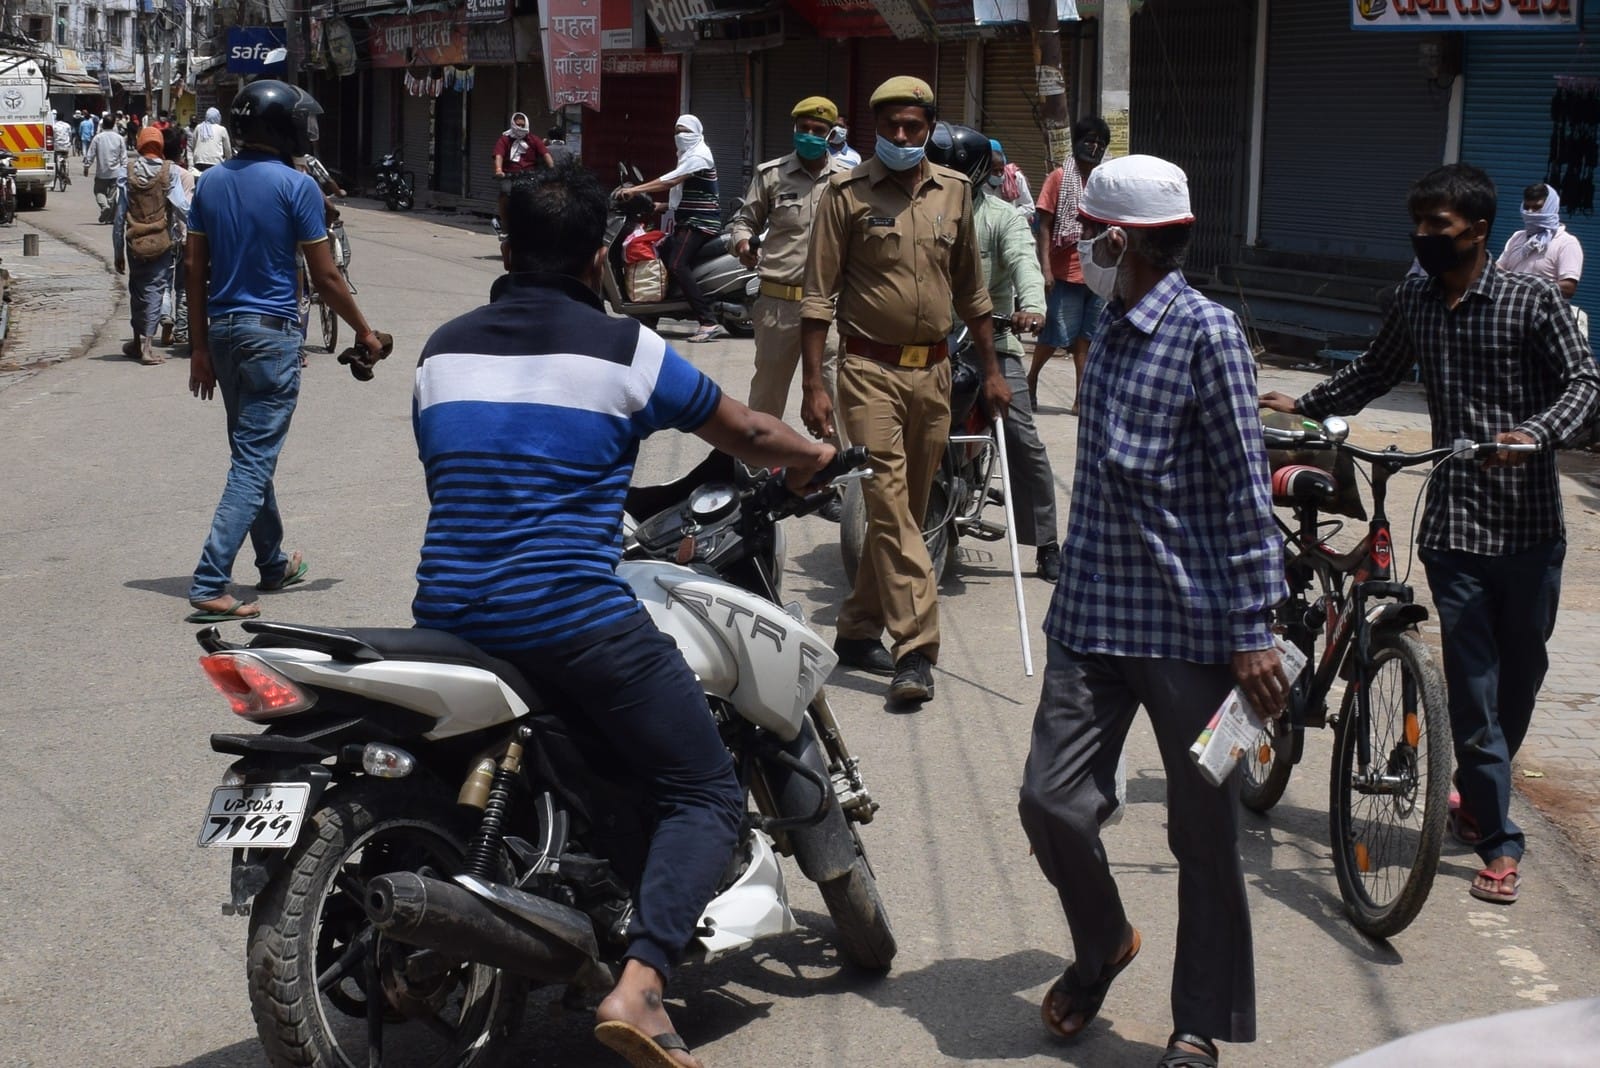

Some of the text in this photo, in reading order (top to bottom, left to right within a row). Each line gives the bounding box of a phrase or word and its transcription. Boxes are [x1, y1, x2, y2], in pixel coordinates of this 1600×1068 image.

[551, 15, 598, 39] महल
[231, 42, 271, 60] safa
[553, 51, 599, 79] साड़ियाँ
[206, 814, 293, 842] 7199
